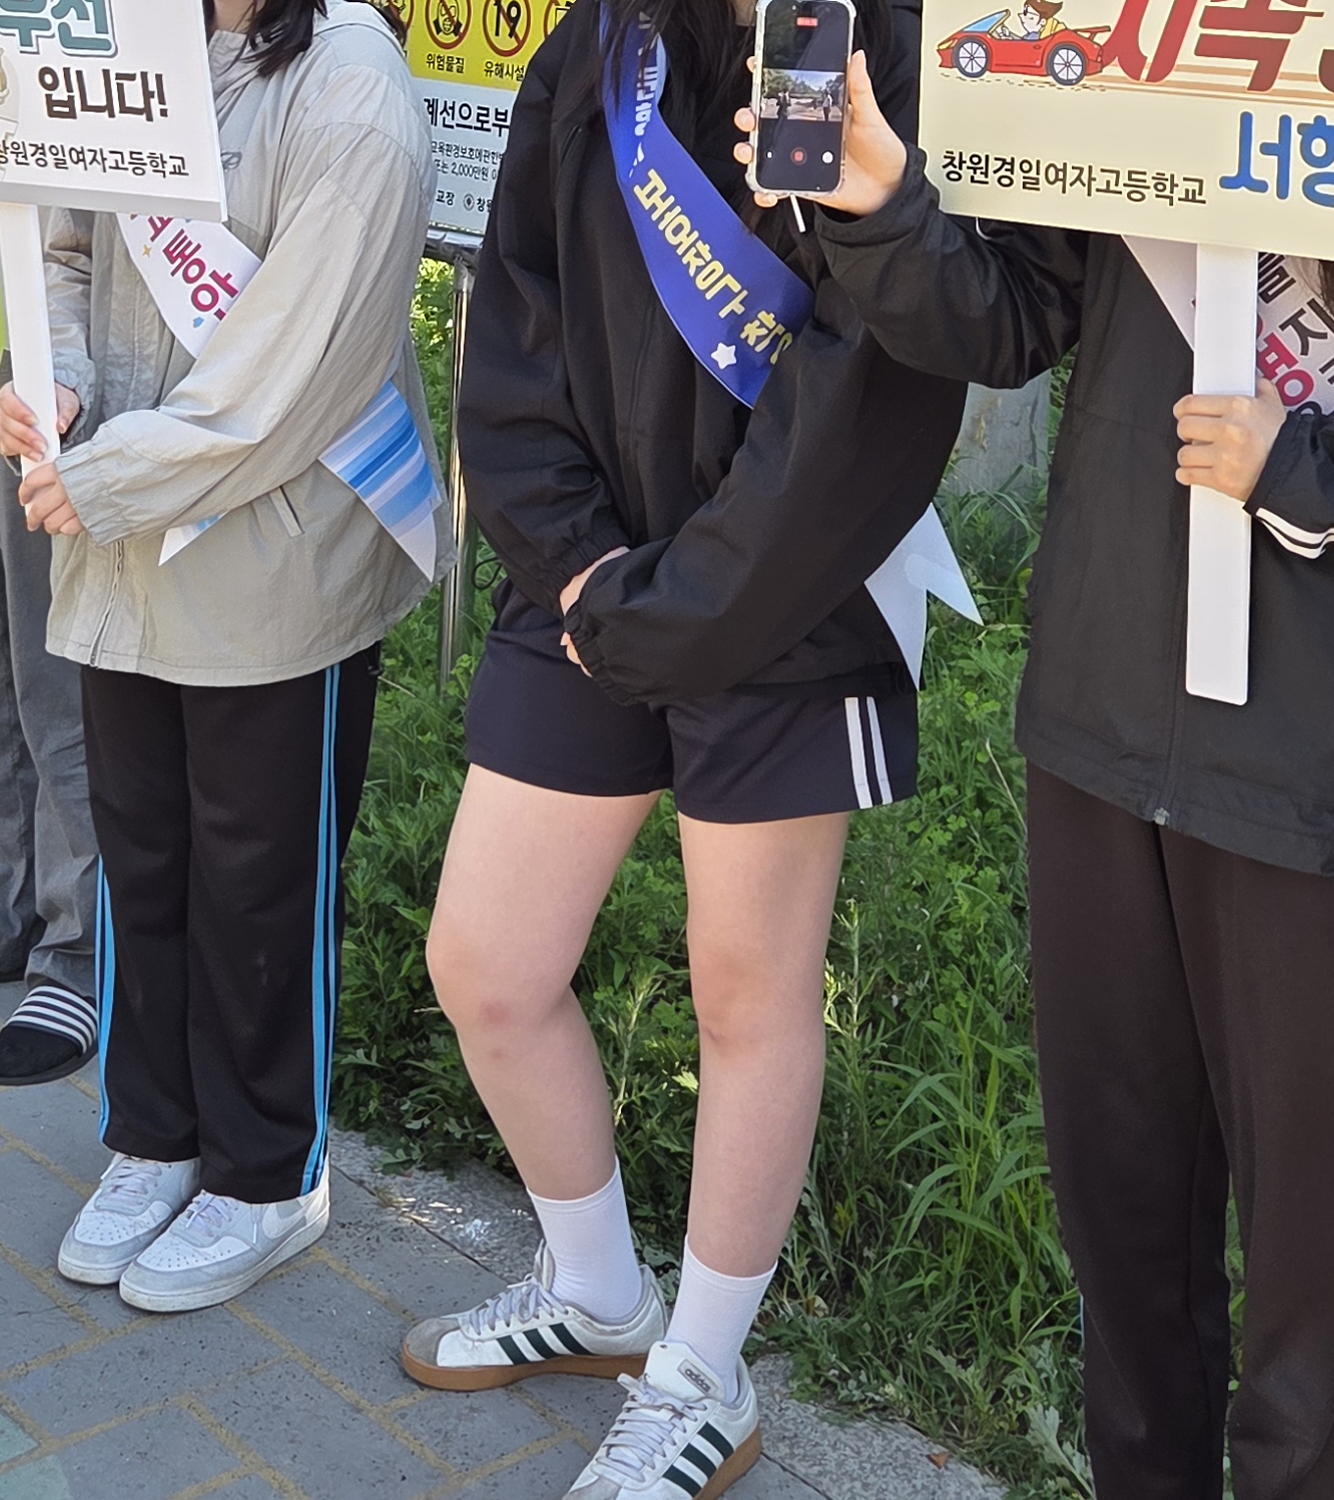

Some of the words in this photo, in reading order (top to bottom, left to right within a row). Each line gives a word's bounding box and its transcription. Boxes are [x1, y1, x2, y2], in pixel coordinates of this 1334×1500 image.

[425, 52, 465, 75] 위험물질
[37, 66, 169, 122] 입니다!
[423, 97, 511, 138] 계선으로부
[940, 150, 1207, 207] 창원경일여자고등학교
[633, 167, 749, 320] 보호장구
